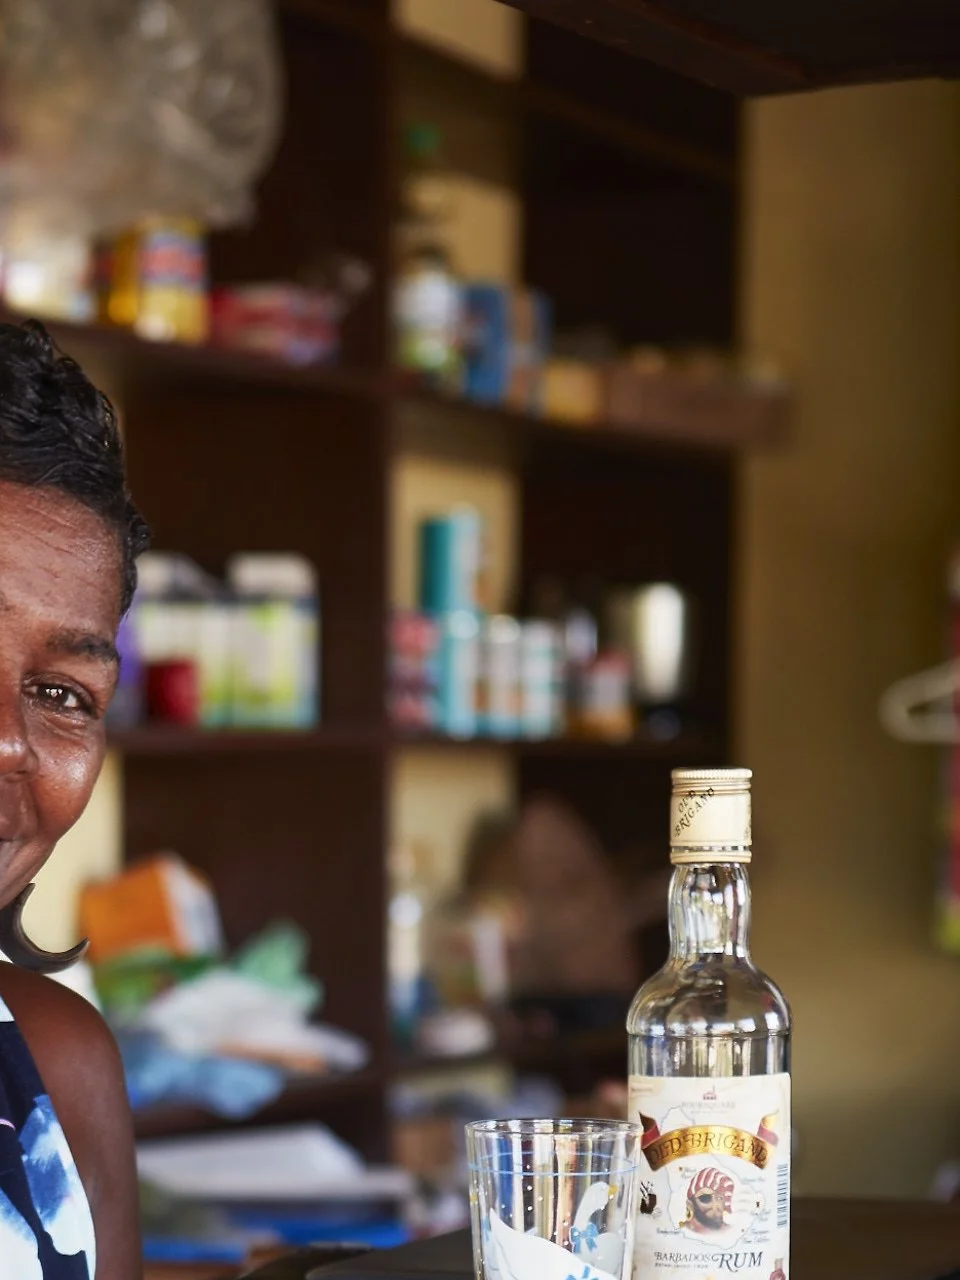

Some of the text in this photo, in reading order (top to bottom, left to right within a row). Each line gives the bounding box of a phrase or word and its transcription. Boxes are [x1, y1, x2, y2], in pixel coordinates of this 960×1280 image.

[674, 787, 715, 838] BRIGAND
[678, 789, 696, 814] OLD
[650, 1131, 768, 1165] OLD BRIGAND
[654, 1250, 763, 1273] BARBADOS RUM
